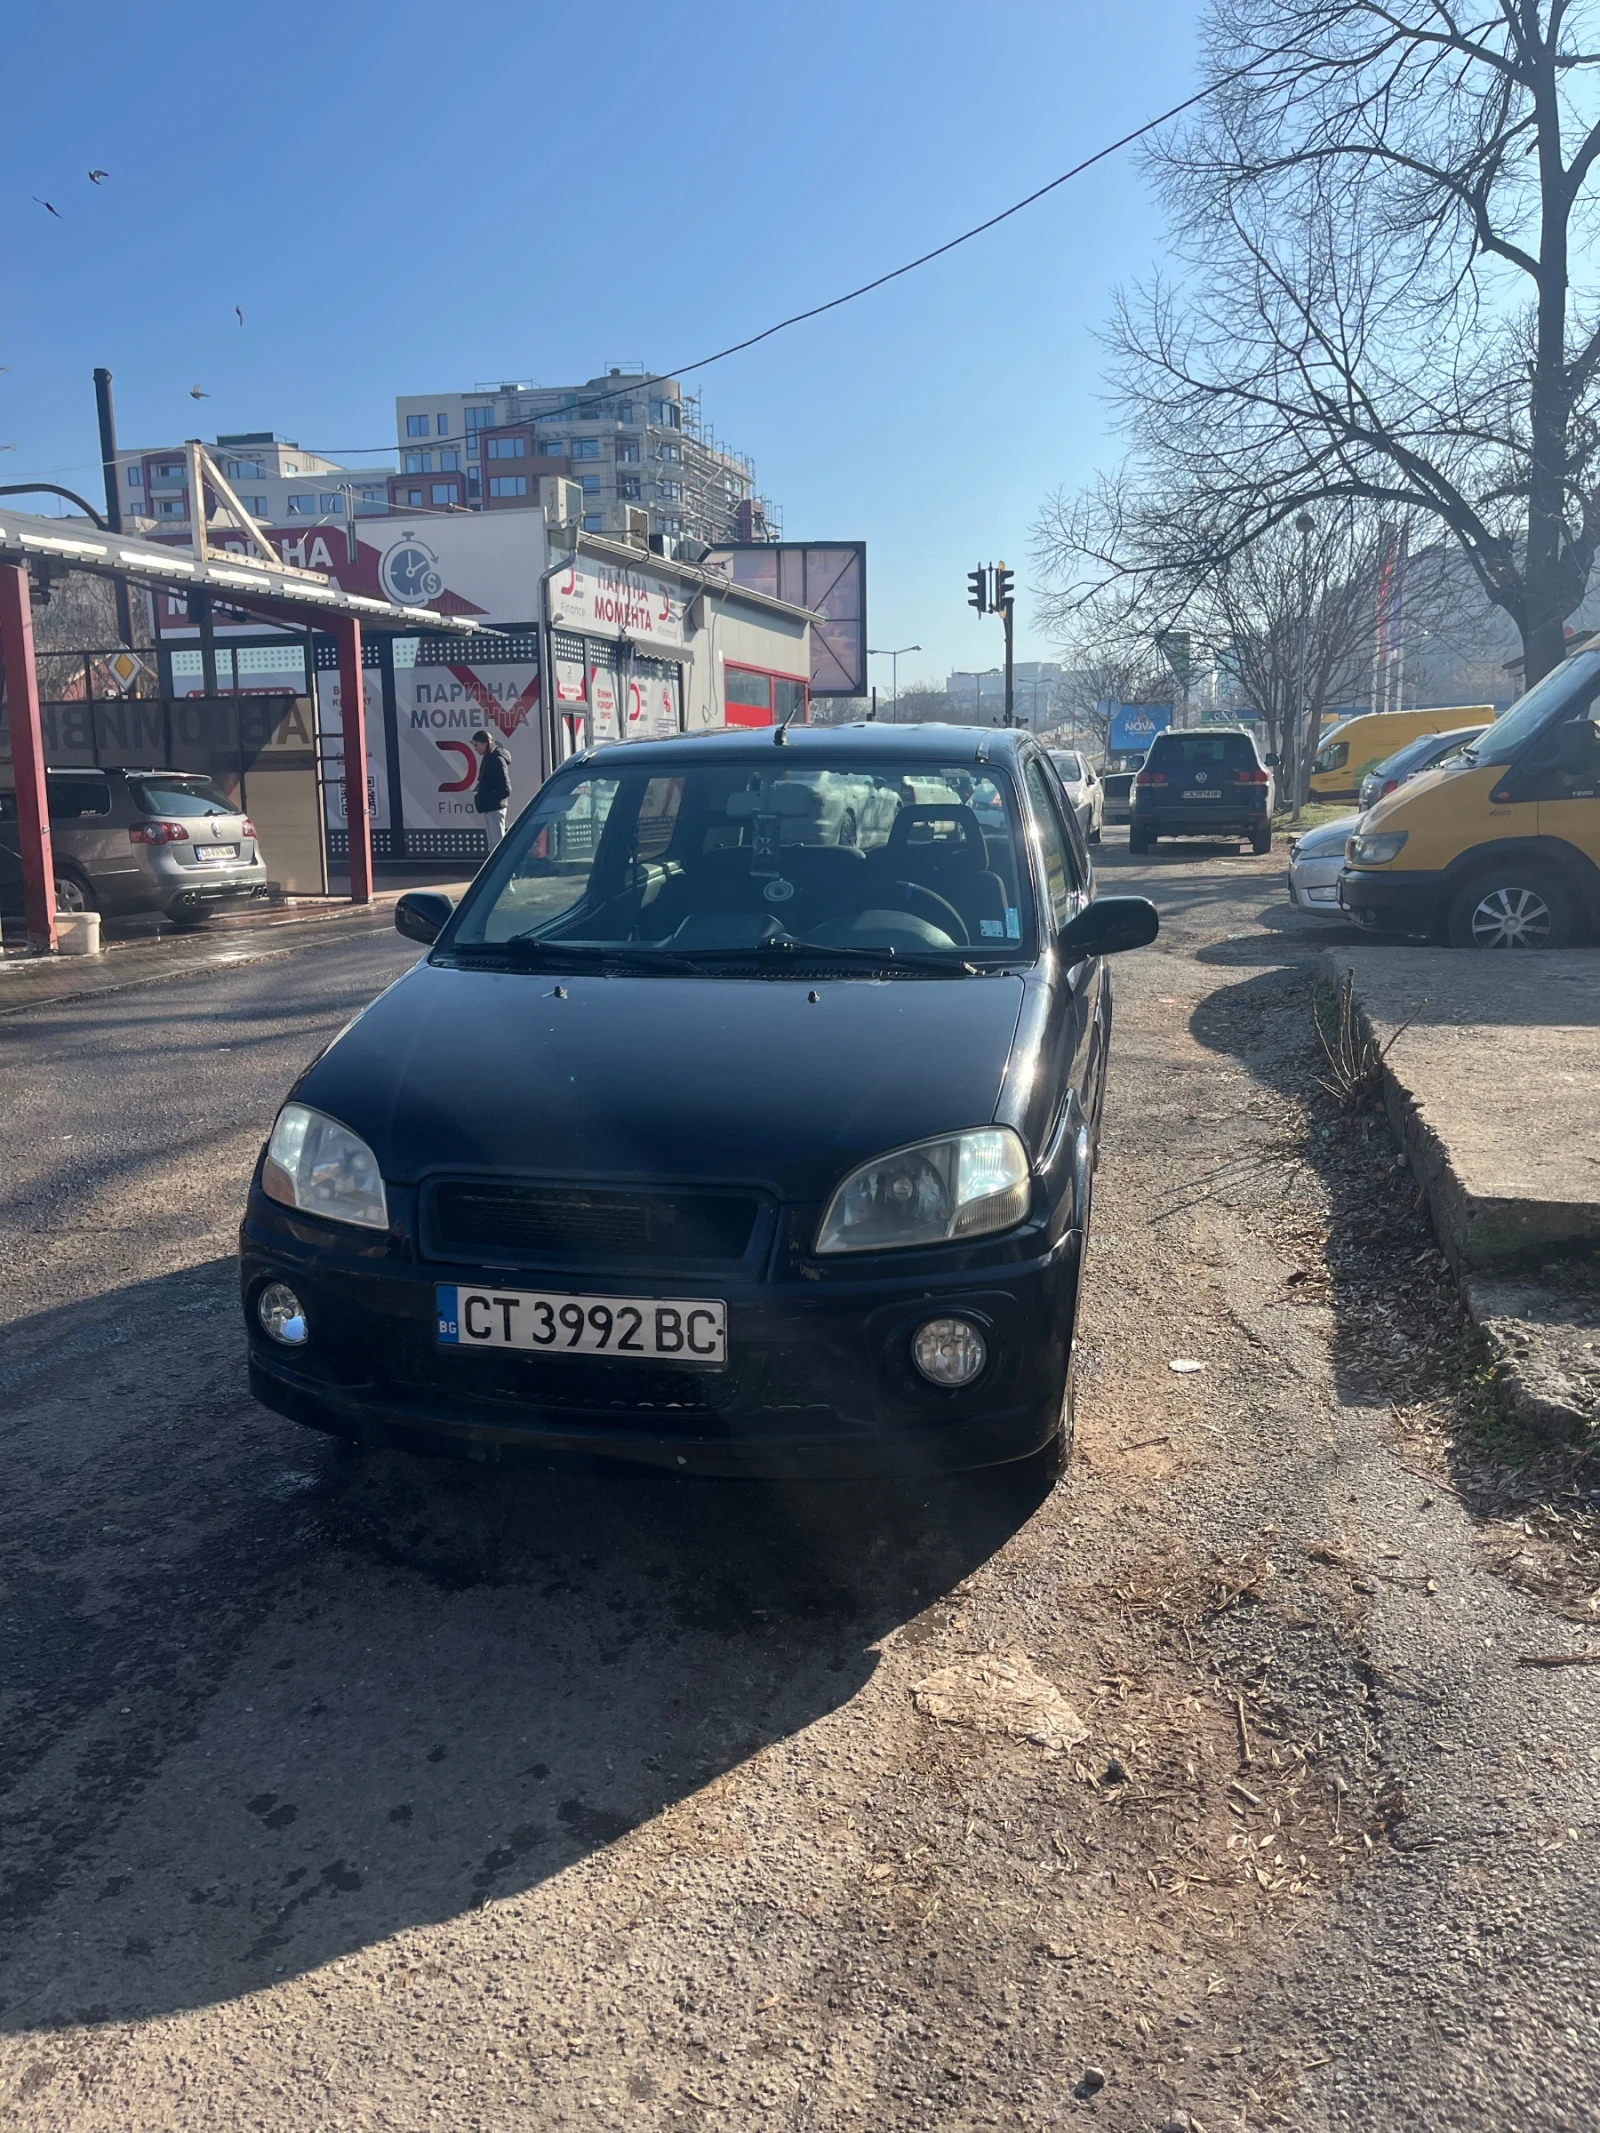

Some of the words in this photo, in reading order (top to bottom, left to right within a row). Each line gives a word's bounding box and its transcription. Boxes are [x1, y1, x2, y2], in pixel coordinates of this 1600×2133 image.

[281, 537, 334, 568] НА
[597, 566, 629, 596] ПАРИ
[560, 602, 586, 618] Finance
[594, 595, 653, 632] МОМЕНТА
[416, 681, 481, 704] ПАРИ
[486, 681, 523, 703] НА
[410, 706, 530, 729] МОМЕНТА
[1124, 721, 1156, 732] NOVA
[438, 802, 475, 814] Fina
[438, 1320, 457, 1335] BG
[464, 1295, 520, 1342] CT
[532, 1301, 644, 1351] 3992
[655, 1307, 716, 1355] BC
